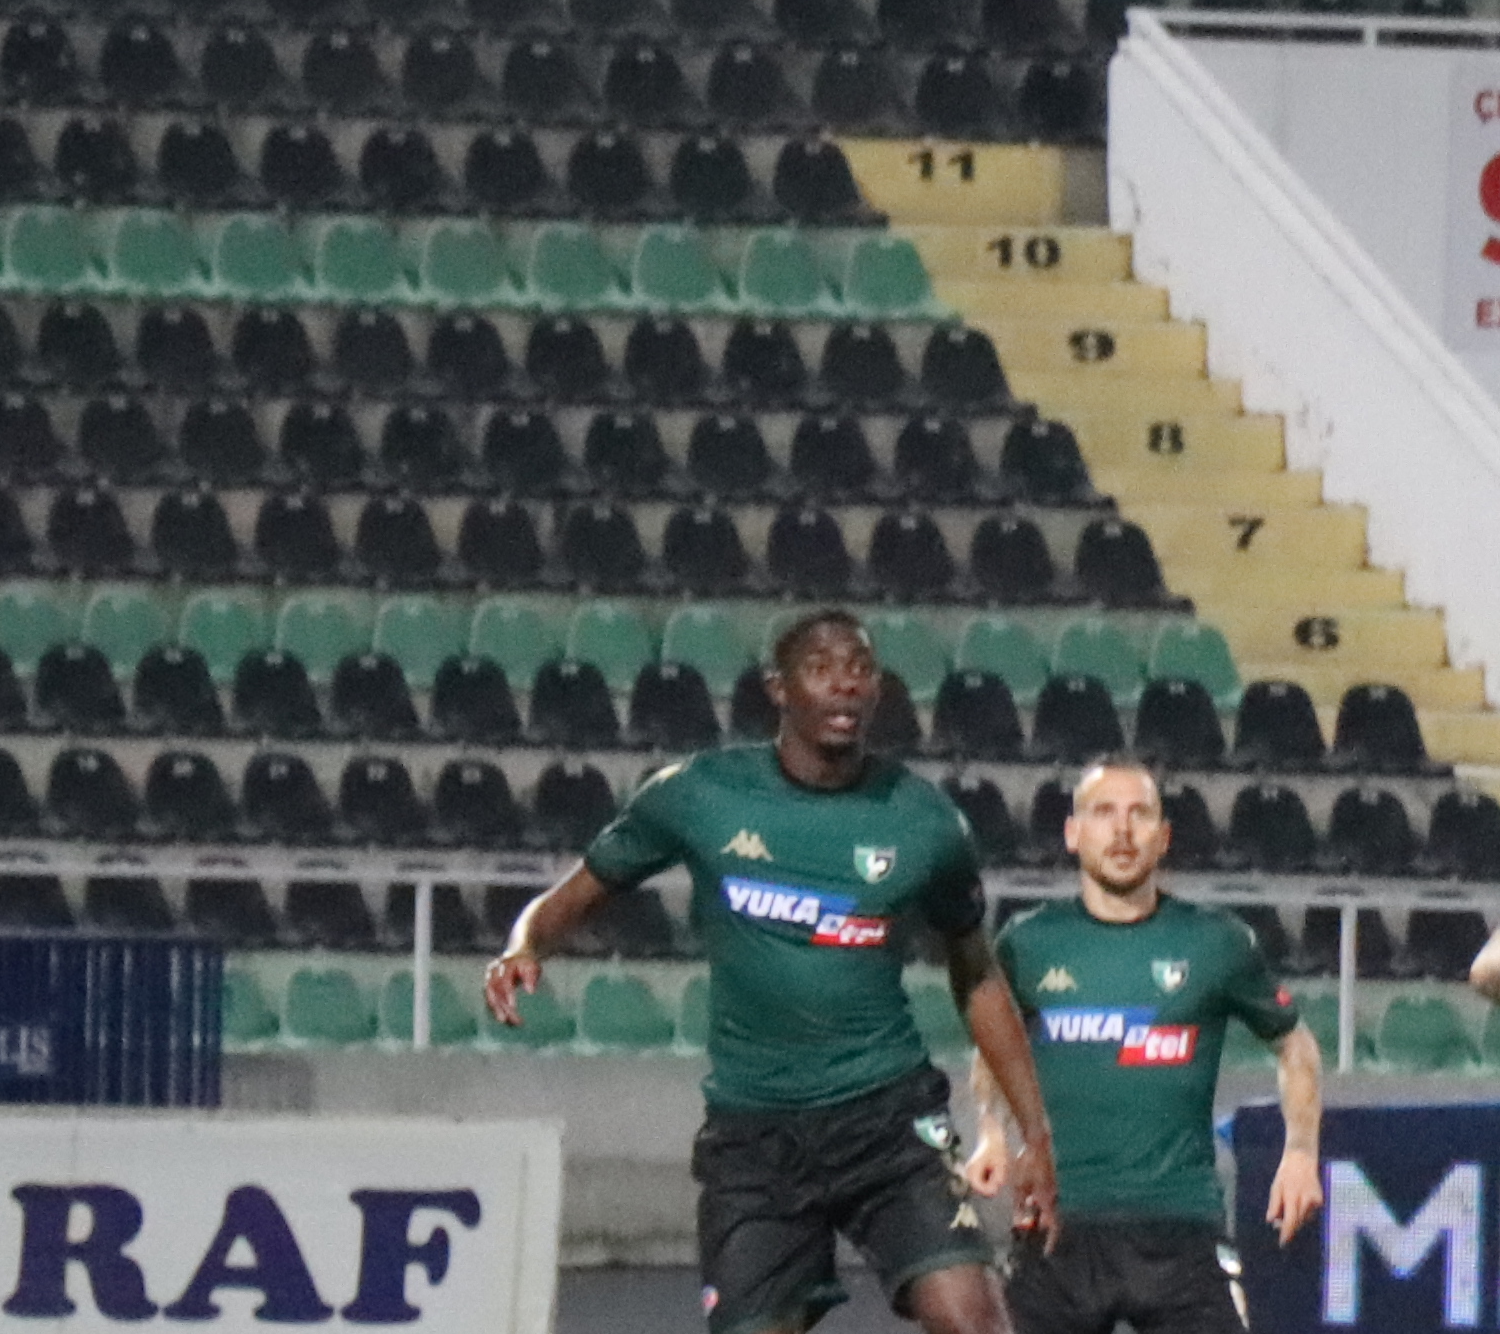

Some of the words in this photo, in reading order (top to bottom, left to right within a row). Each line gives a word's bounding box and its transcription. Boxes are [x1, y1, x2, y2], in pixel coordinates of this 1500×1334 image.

[906, 149, 977, 183] 11
[985, 235, 1062, 269] 10
[1067, 331, 1116, 364] 9
[1147, 421, 1186, 456] 8
[1227, 514, 1266, 551] 7
[1293, 617, 1341, 650] 6
[726, 883, 821, 926] YUKA
[1044, 1012, 1126, 1043] YUKA
[2, 1184, 484, 1327] RAF
